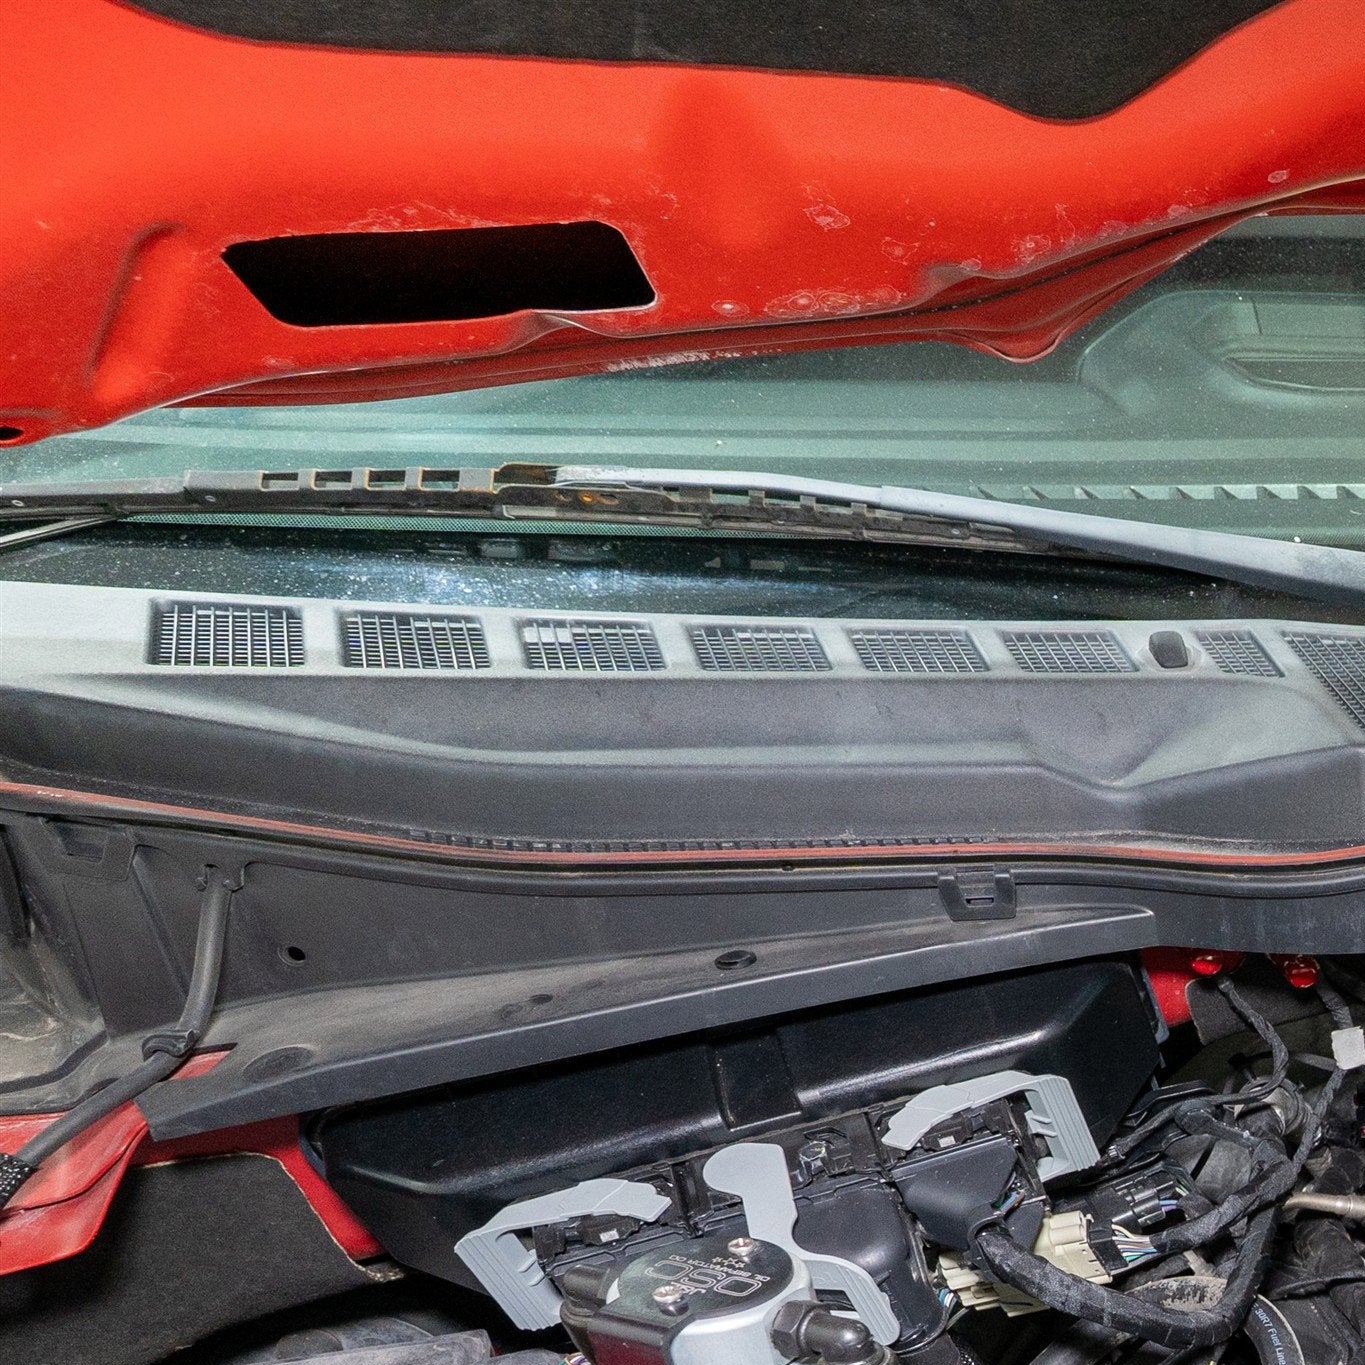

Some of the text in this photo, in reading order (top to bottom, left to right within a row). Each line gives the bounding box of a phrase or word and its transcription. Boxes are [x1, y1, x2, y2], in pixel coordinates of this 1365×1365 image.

[645, 1260, 762, 1297] OSC
[688, 1258, 752, 1280] SEPARATOR
[1267, 1327, 1283, 1347] Fuel
[1272, 1346, 1289, 1365] Line
